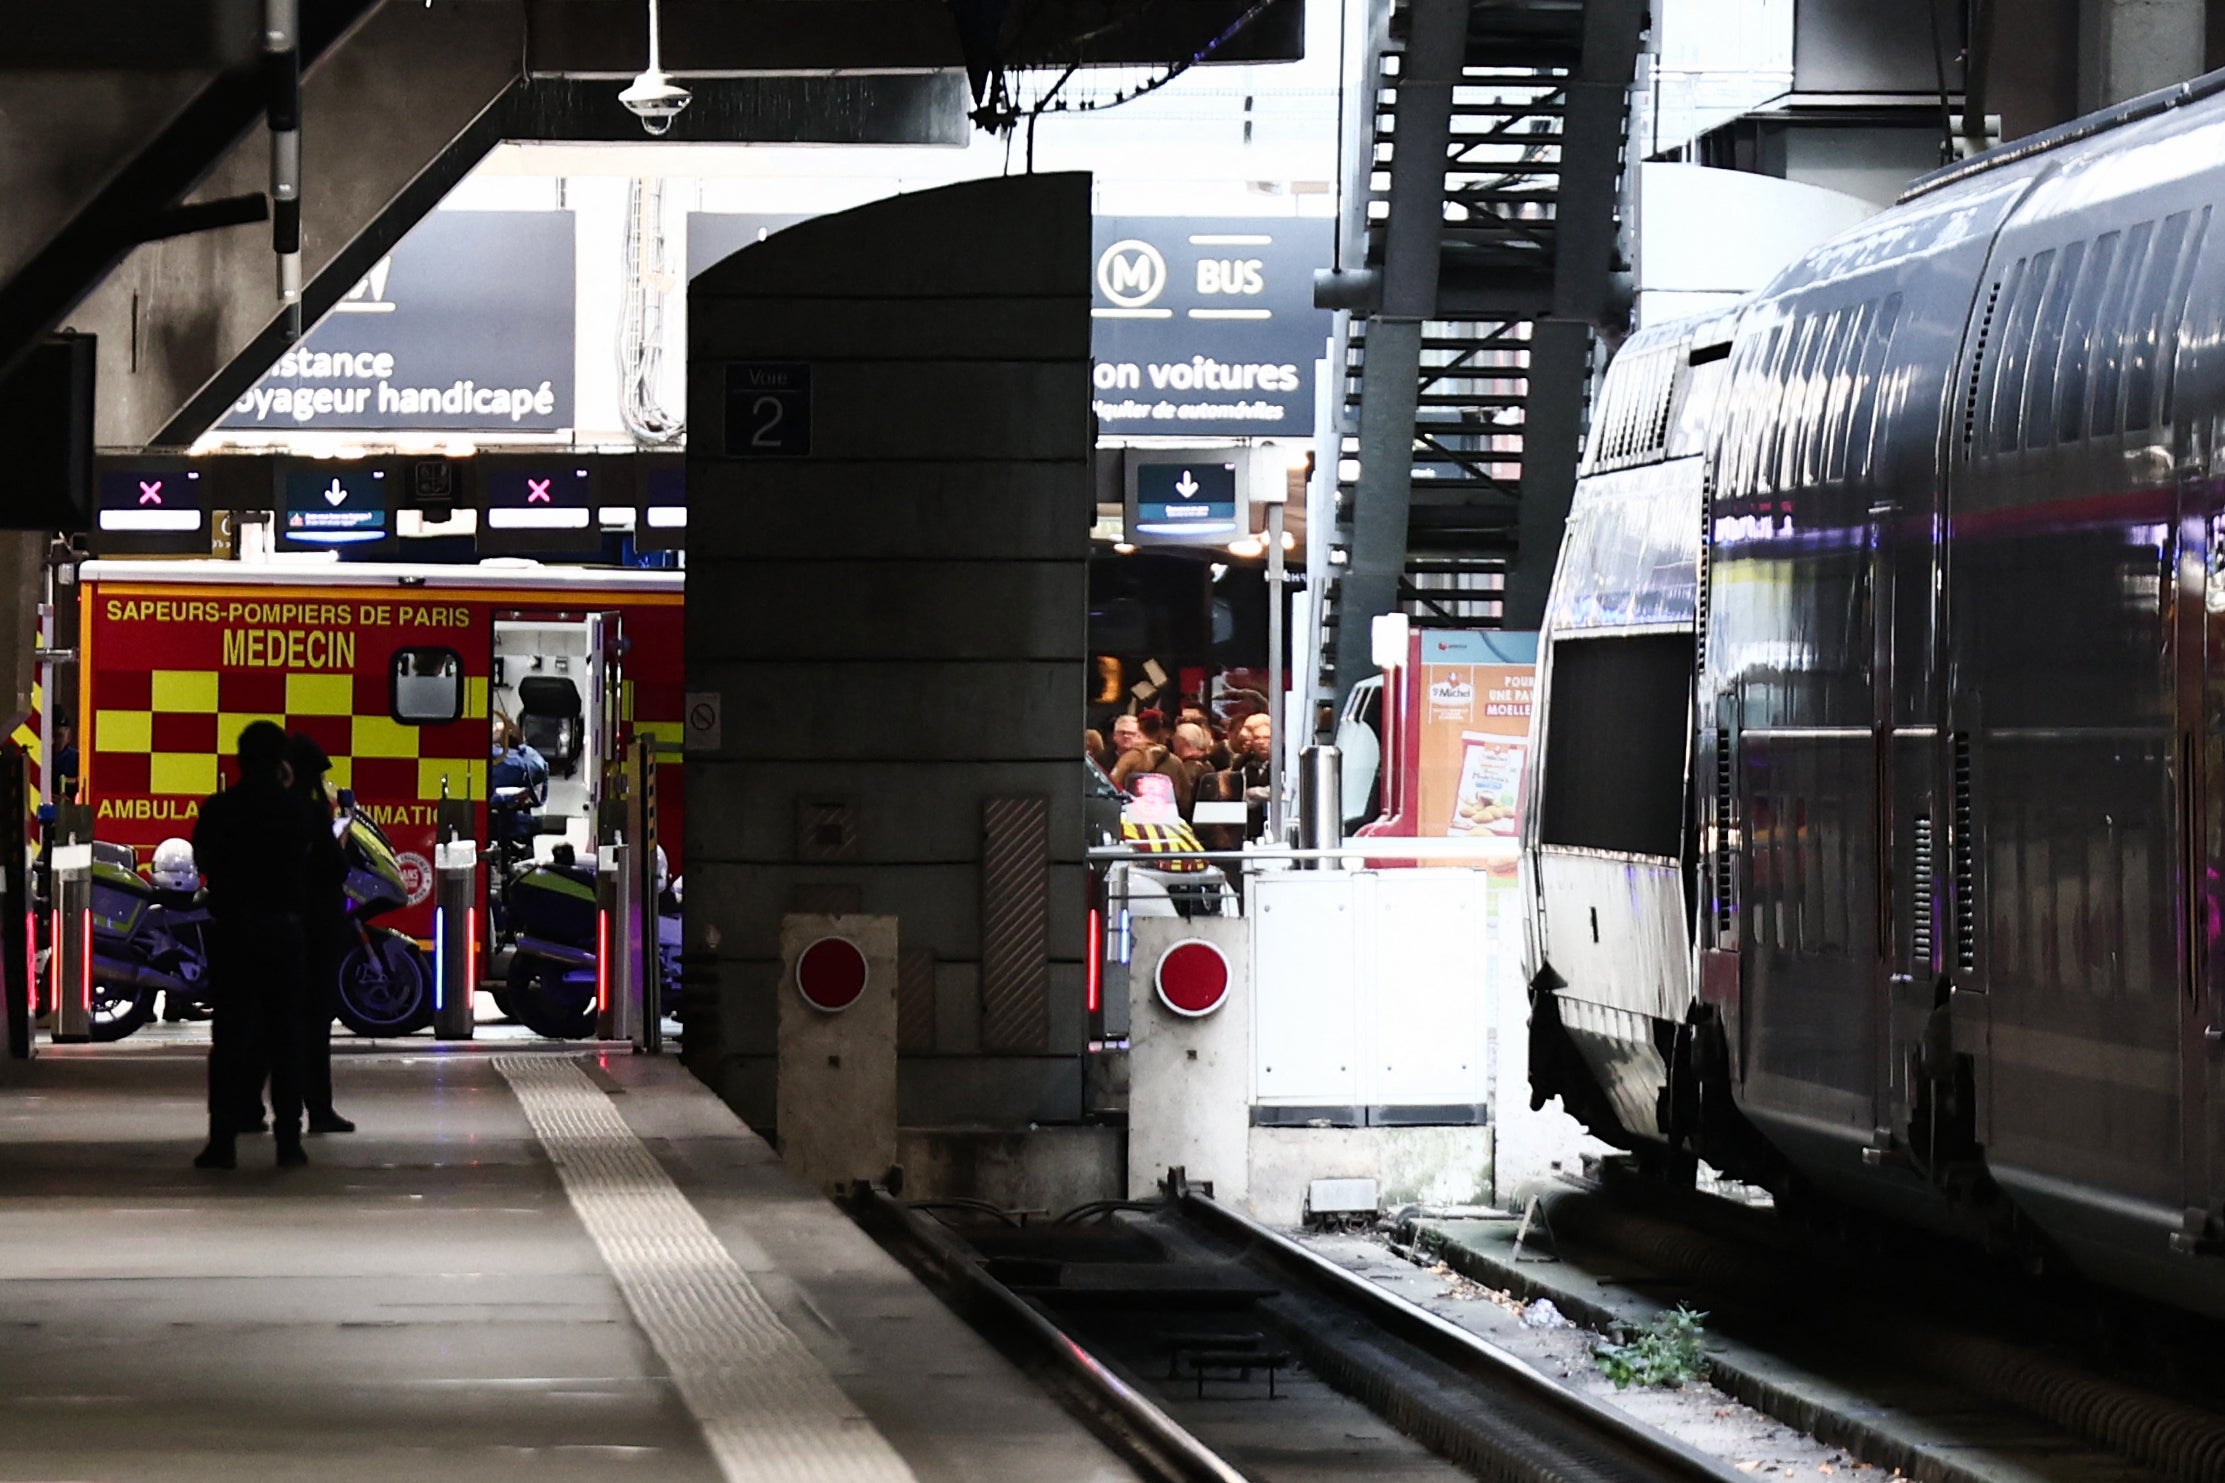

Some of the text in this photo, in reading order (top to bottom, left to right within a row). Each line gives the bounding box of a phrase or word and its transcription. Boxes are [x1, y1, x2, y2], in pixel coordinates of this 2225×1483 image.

[1197, 259, 1264, 295] BUS
[748, 368, 789, 386] Voie
[1148, 355, 1299, 391] voitures
[378, 380, 555, 422] handicapé
[1152, 400, 1177, 419] de
[751, 396, 784, 447] 2
[107, 600, 470, 628] SAPEURS-POMPIERS DE PARIS
[223, 628, 355, 668] MEDECIN
[1489, 689, 1513, 701] UNE
[97, 799, 200, 820] AMBULA
